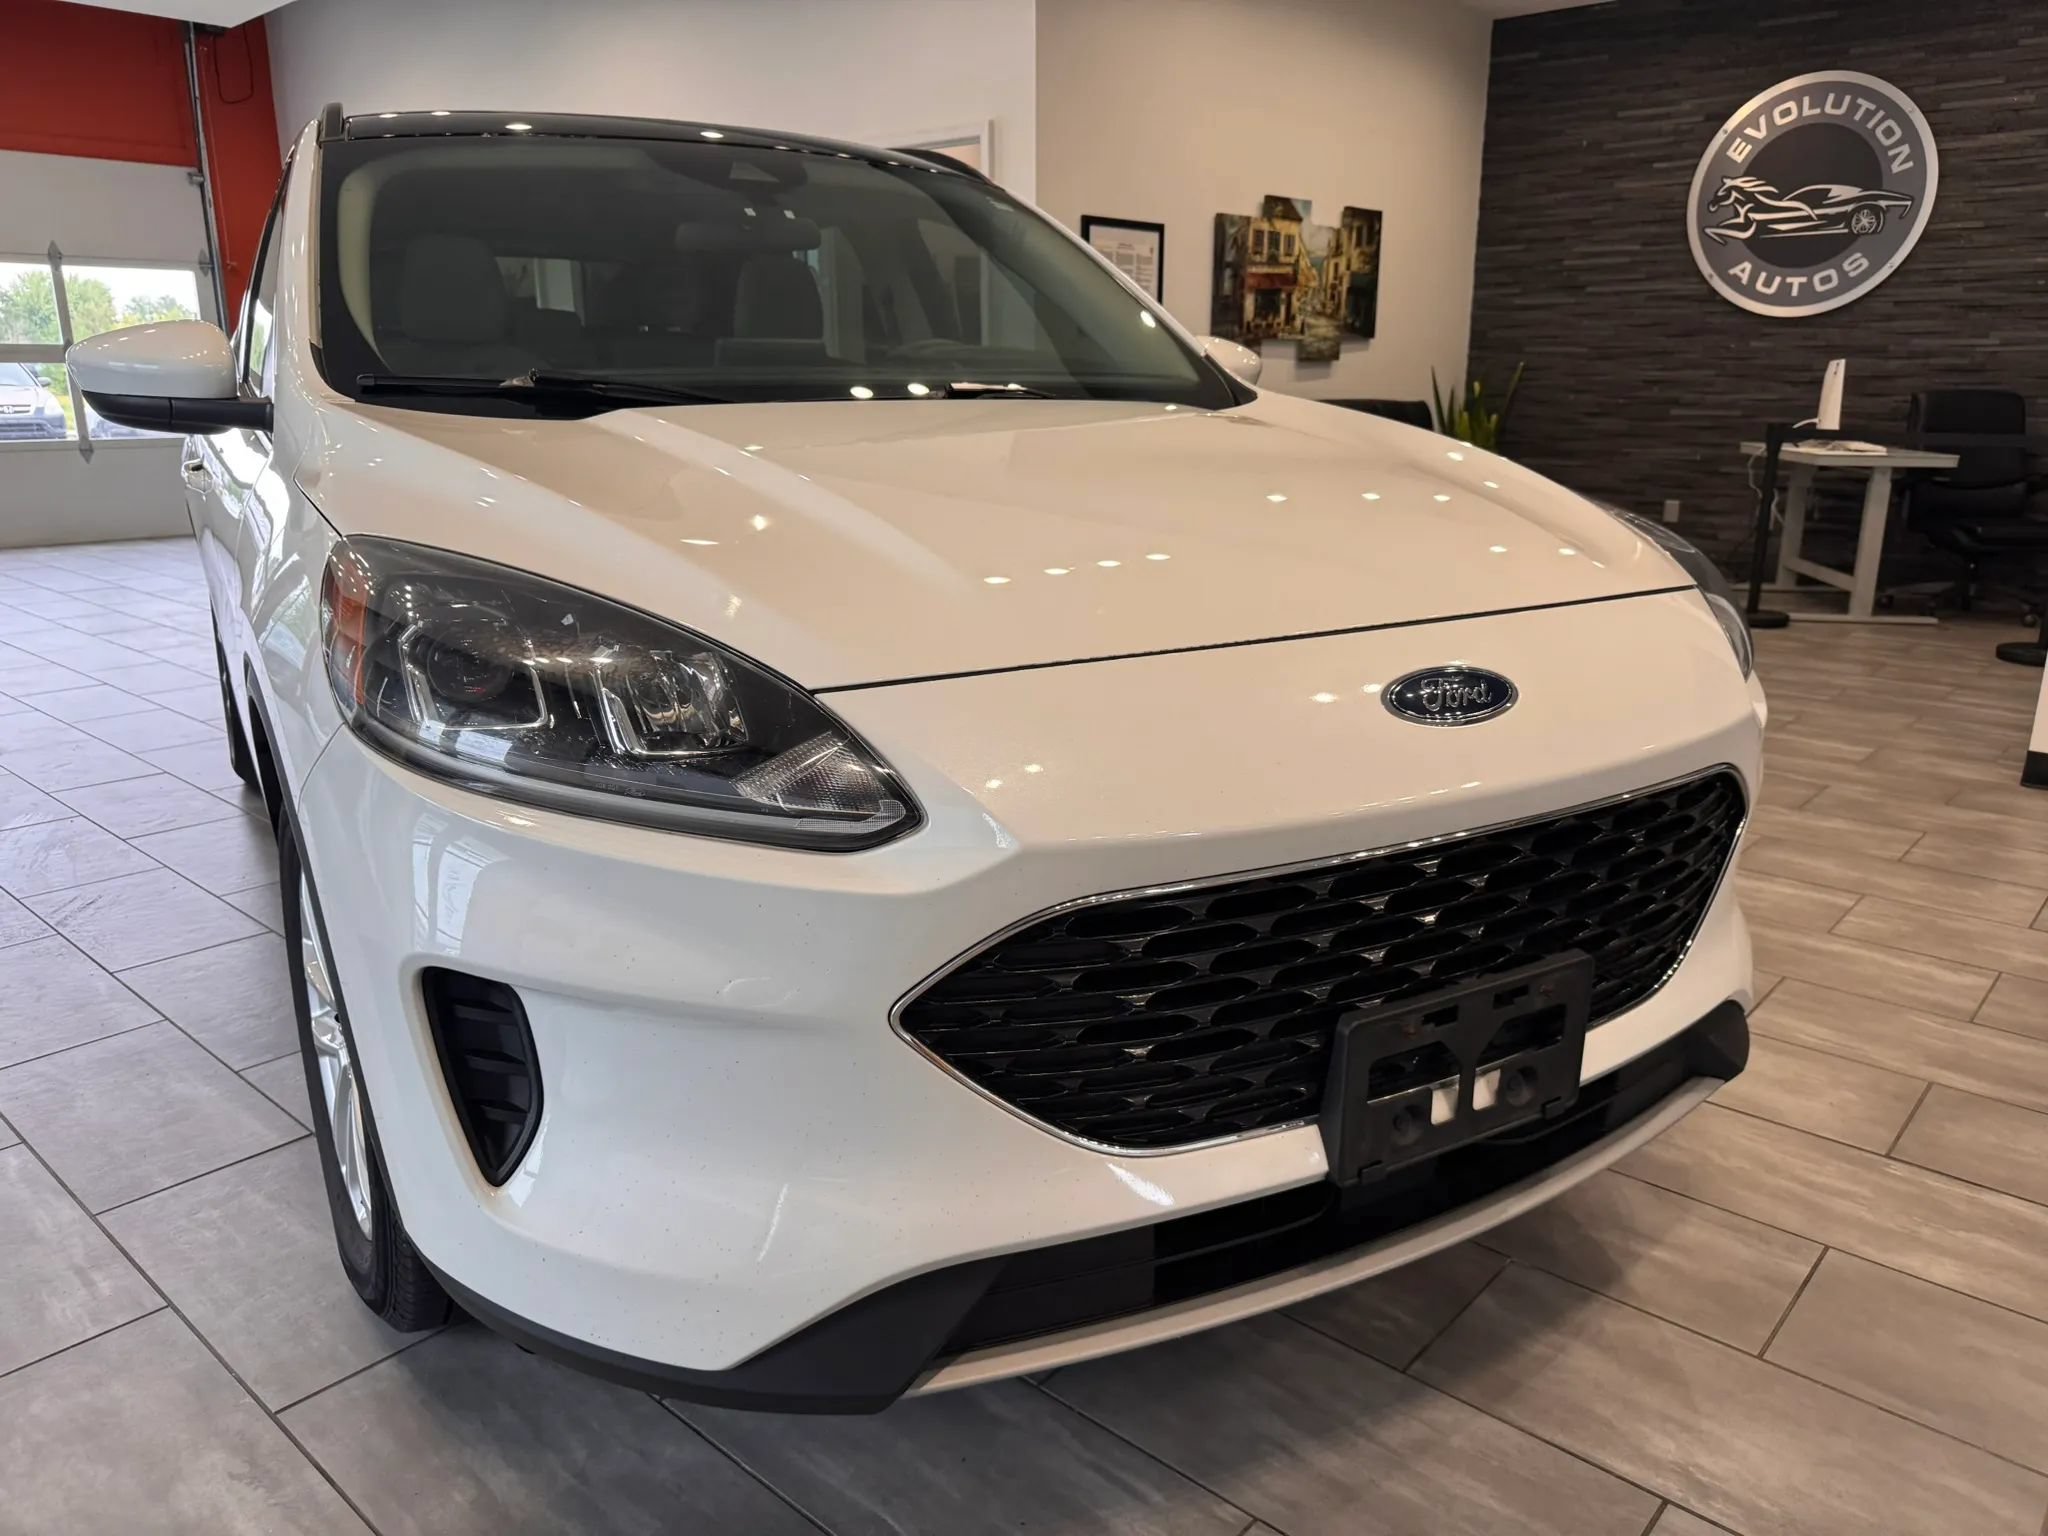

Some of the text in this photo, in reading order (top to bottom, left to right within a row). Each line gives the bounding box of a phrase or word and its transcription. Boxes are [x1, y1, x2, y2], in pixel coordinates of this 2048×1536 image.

[1726, 93, 1914, 174] EVOLUTION
[1728, 252, 1869, 297] AUTOS
[1420, 675, 1493, 711] Ford
